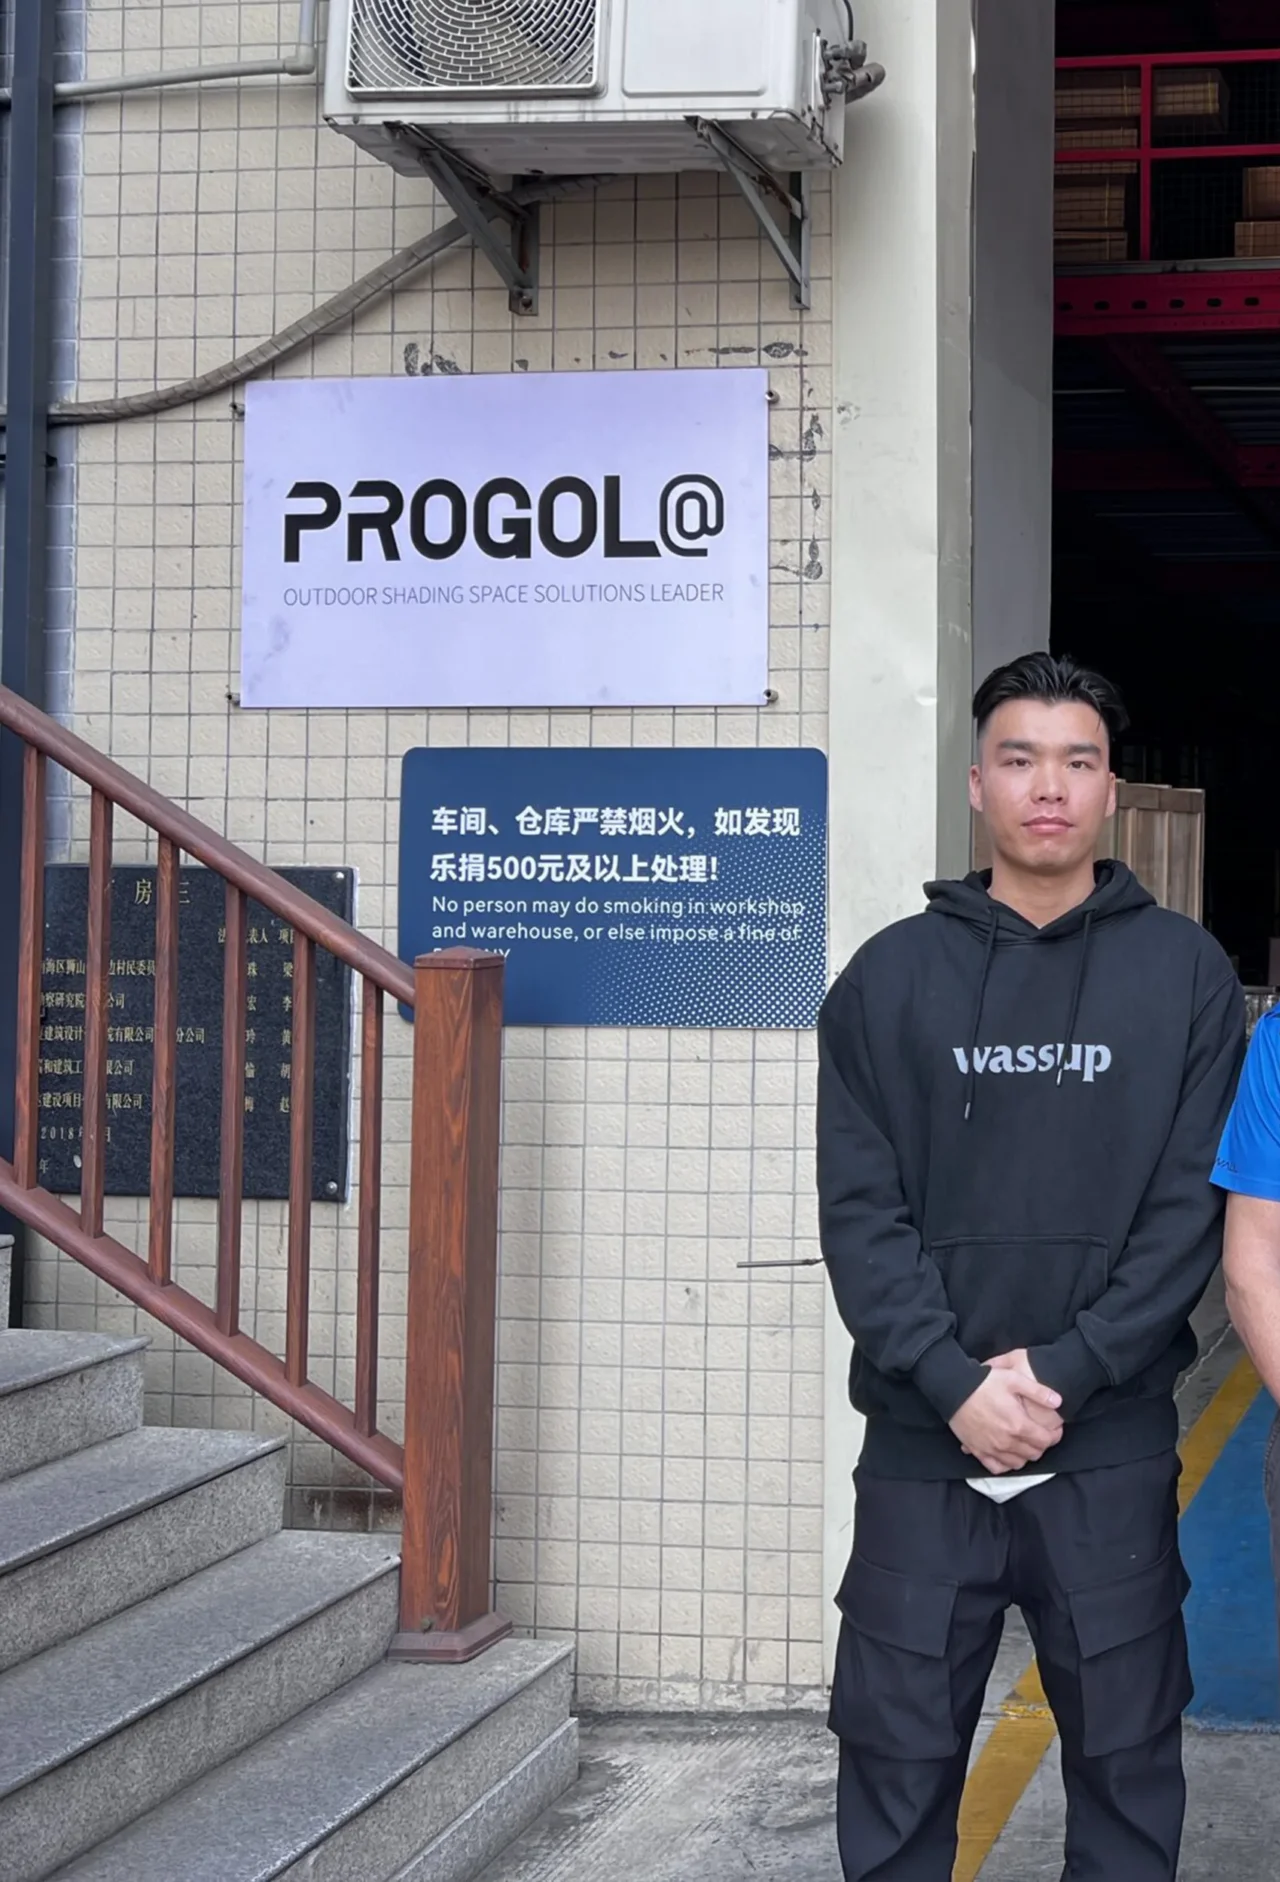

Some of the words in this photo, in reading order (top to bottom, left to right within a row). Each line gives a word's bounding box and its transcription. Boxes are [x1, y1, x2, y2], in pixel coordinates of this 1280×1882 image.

[283, 473, 725, 563] PROGOL@
[283, 588, 377, 606] OUTDOOR
[381, 586, 464, 604] SHADING
[469, 585, 528, 603] SPACE
[534, 584, 645, 602] SOLUTIONS
[650, 583, 724, 602] LEADER
[431, 805, 800, 838] 车间、仓库严禁烟火，如发现
[430, 853, 719, 883] 乐捐500元及以上处理!
[432, 896, 458, 913] No
[463, 899, 527, 916] person
[532, 899, 570, 917] may
[575, 896, 599, 913] do
[603, 897, 683, 918] smoking
[688, 897, 705, 914] in
[710, 897, 805, 918] workshop
[432, 922, 466, 939] and
[471, 922, 579, 941] warehouse,
[583, 927, 604, 940] or
[608, 924, 645, 940] else
[650, 924, 719, 944] impose
[723, 927, 734, 941] a
[739, 923, 776, 941] fine
[780, 923, 802, 941] of
[953, 1043, 1112, 1082] wassup
